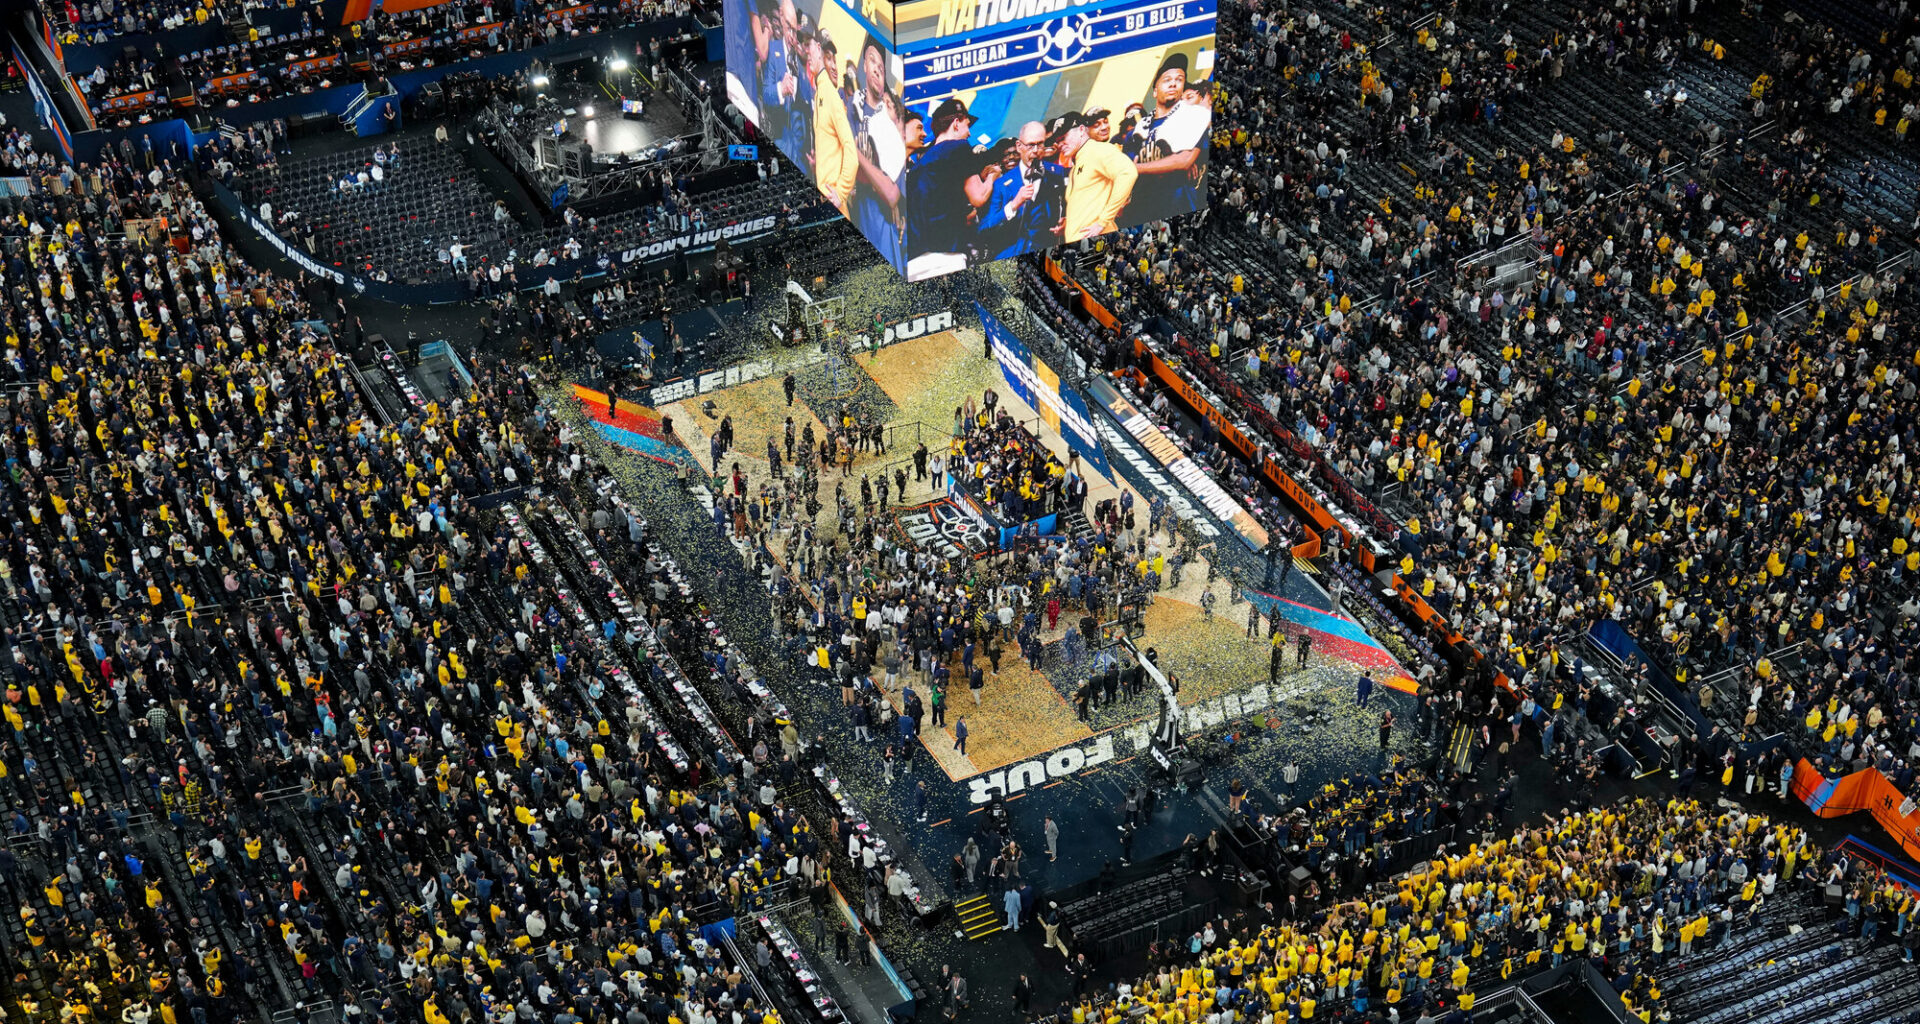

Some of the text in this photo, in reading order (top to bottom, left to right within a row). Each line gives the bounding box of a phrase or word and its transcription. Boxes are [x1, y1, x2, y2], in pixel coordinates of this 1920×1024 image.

[1150, 4, 1184, 25] BLUE
[933, 43, 1007, 73] MICHIGAN
[251, 217, 344, 285] UCONN HUSKIS
[622, 216, 777, 263] UCONN HUSKIES
[1122, 412, 1243, 521] NATIONAL CHAMPIONS
[1182, 384, 1202, 409] 2026
[1265, 461, 1290, 490] FINAL
[1293, 486, 1315, 514] FOUR
[968, 735, 1114, 804] FOUR
[1151, 746, 1170, 771] NCAA
